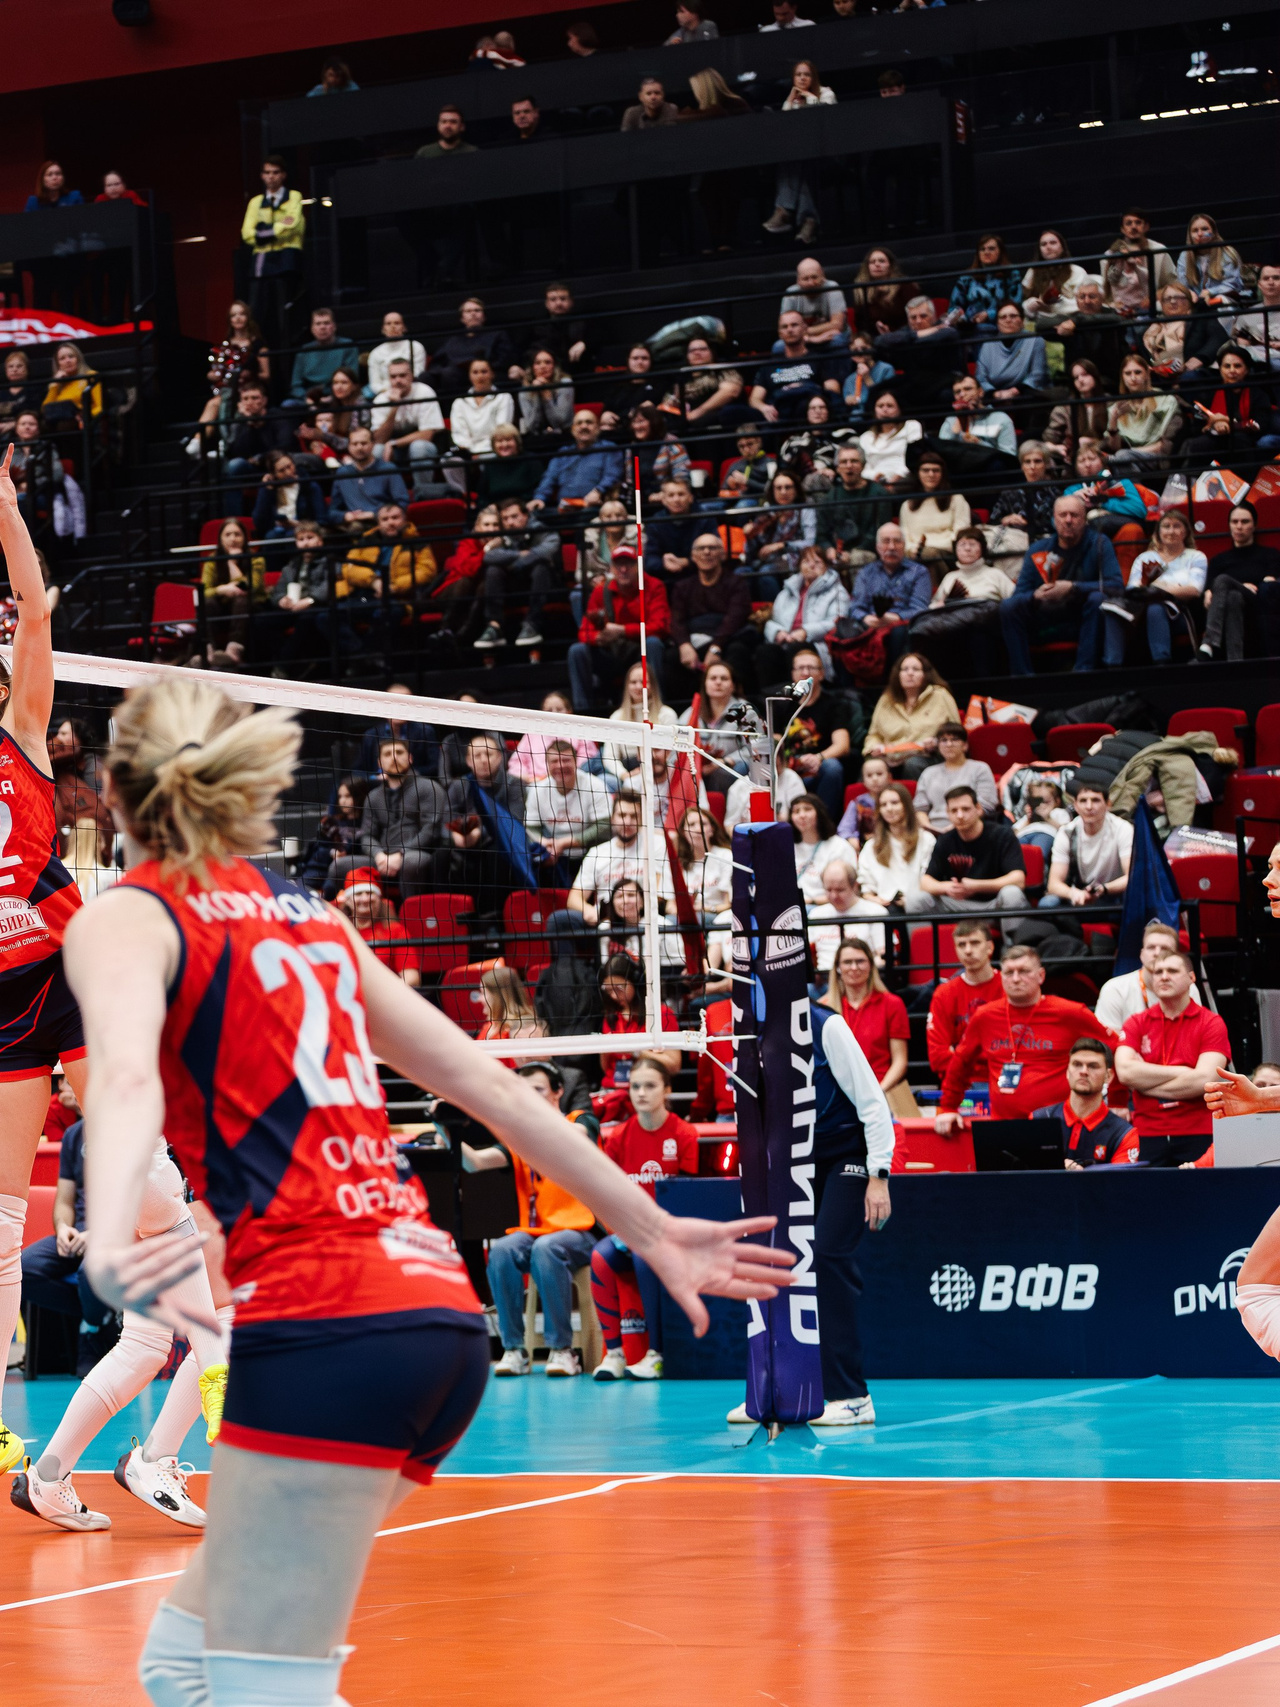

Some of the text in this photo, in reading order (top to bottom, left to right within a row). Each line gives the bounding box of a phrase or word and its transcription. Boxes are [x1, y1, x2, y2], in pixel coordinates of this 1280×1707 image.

[22, 933, 50, 946] СПОНСОР
[251, 938, 385, 1109] 23
[789, 997, 820, 1345] ОМИЧКА
[979, 1263, 1099, 1311] ВФВ
